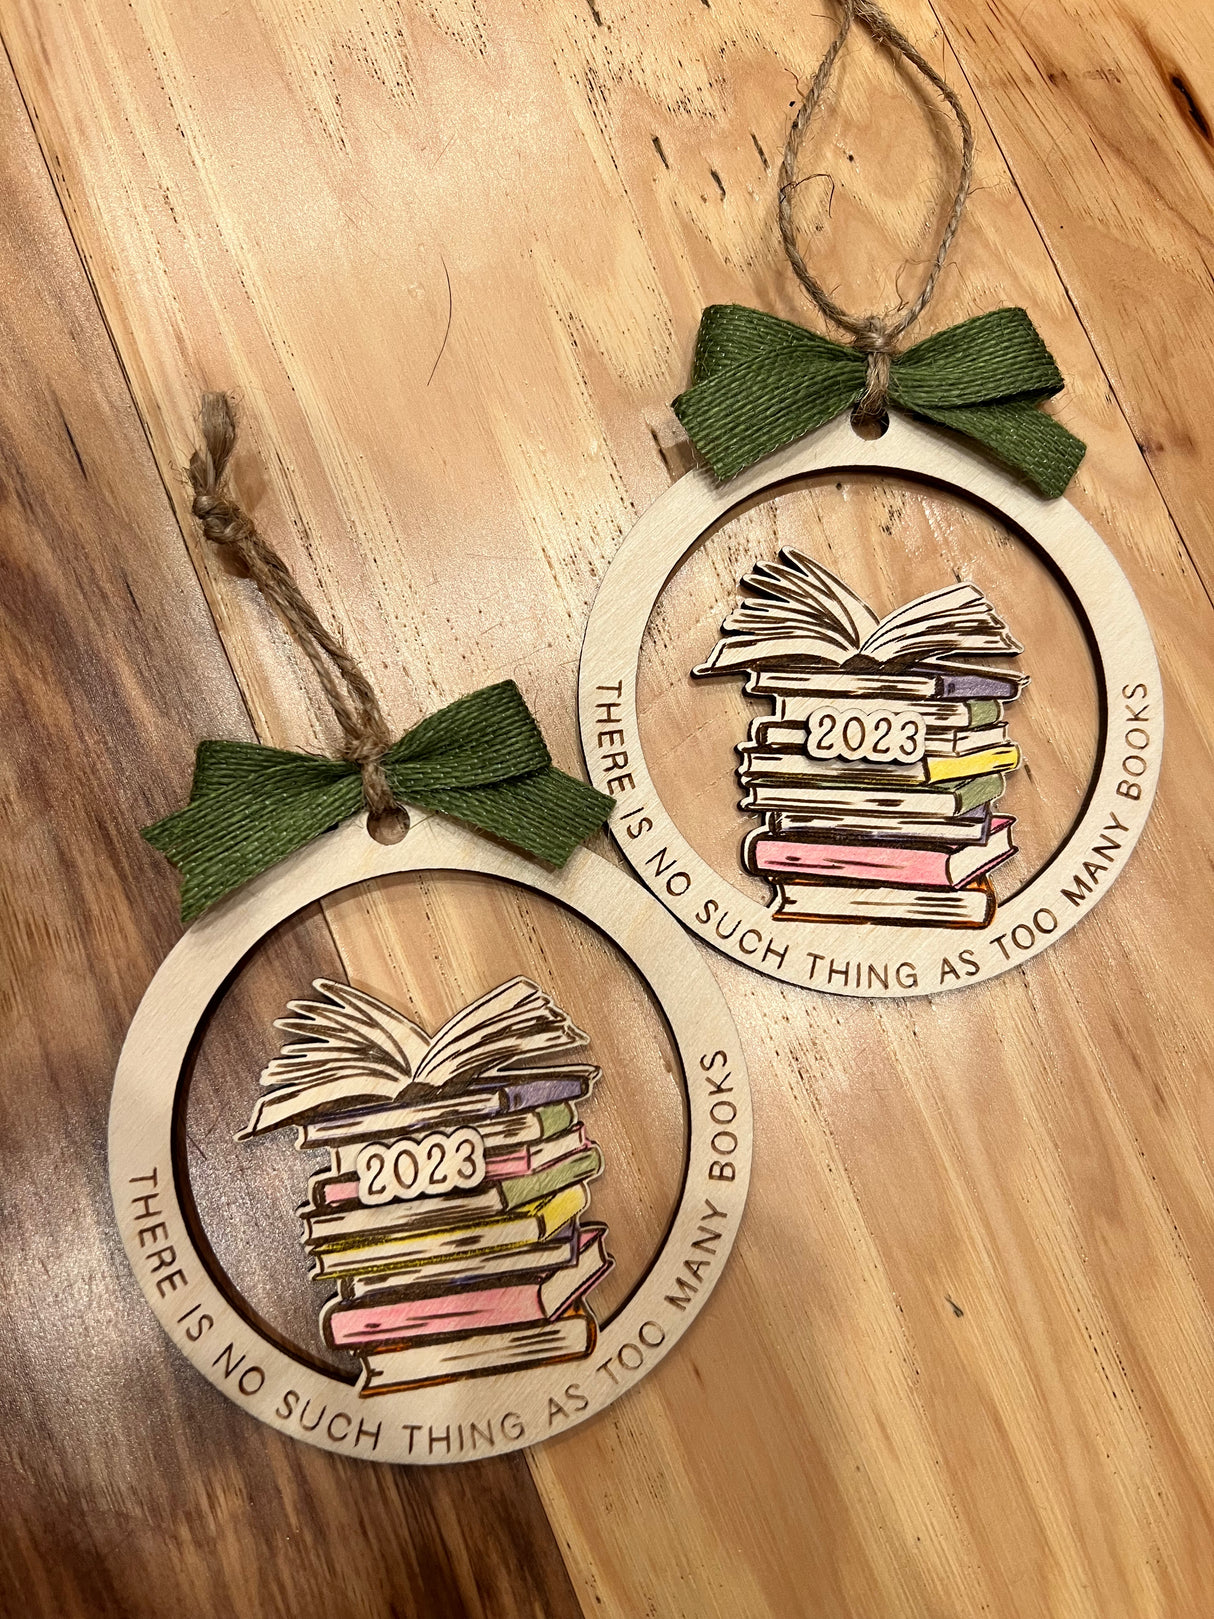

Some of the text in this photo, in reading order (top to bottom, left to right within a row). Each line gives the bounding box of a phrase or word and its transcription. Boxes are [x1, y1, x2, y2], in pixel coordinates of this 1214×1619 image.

[814, 714, 919, 753] 2023
[596, 680, 1150, 990] THERE IS NO SUCH THING AS TOO MANY BOOKS
[129, 1050, 739, 1456] THERE IS NO SUCH THING AS TOO MANY BOOKS
[364, 1141, 478, 1195] 2023
